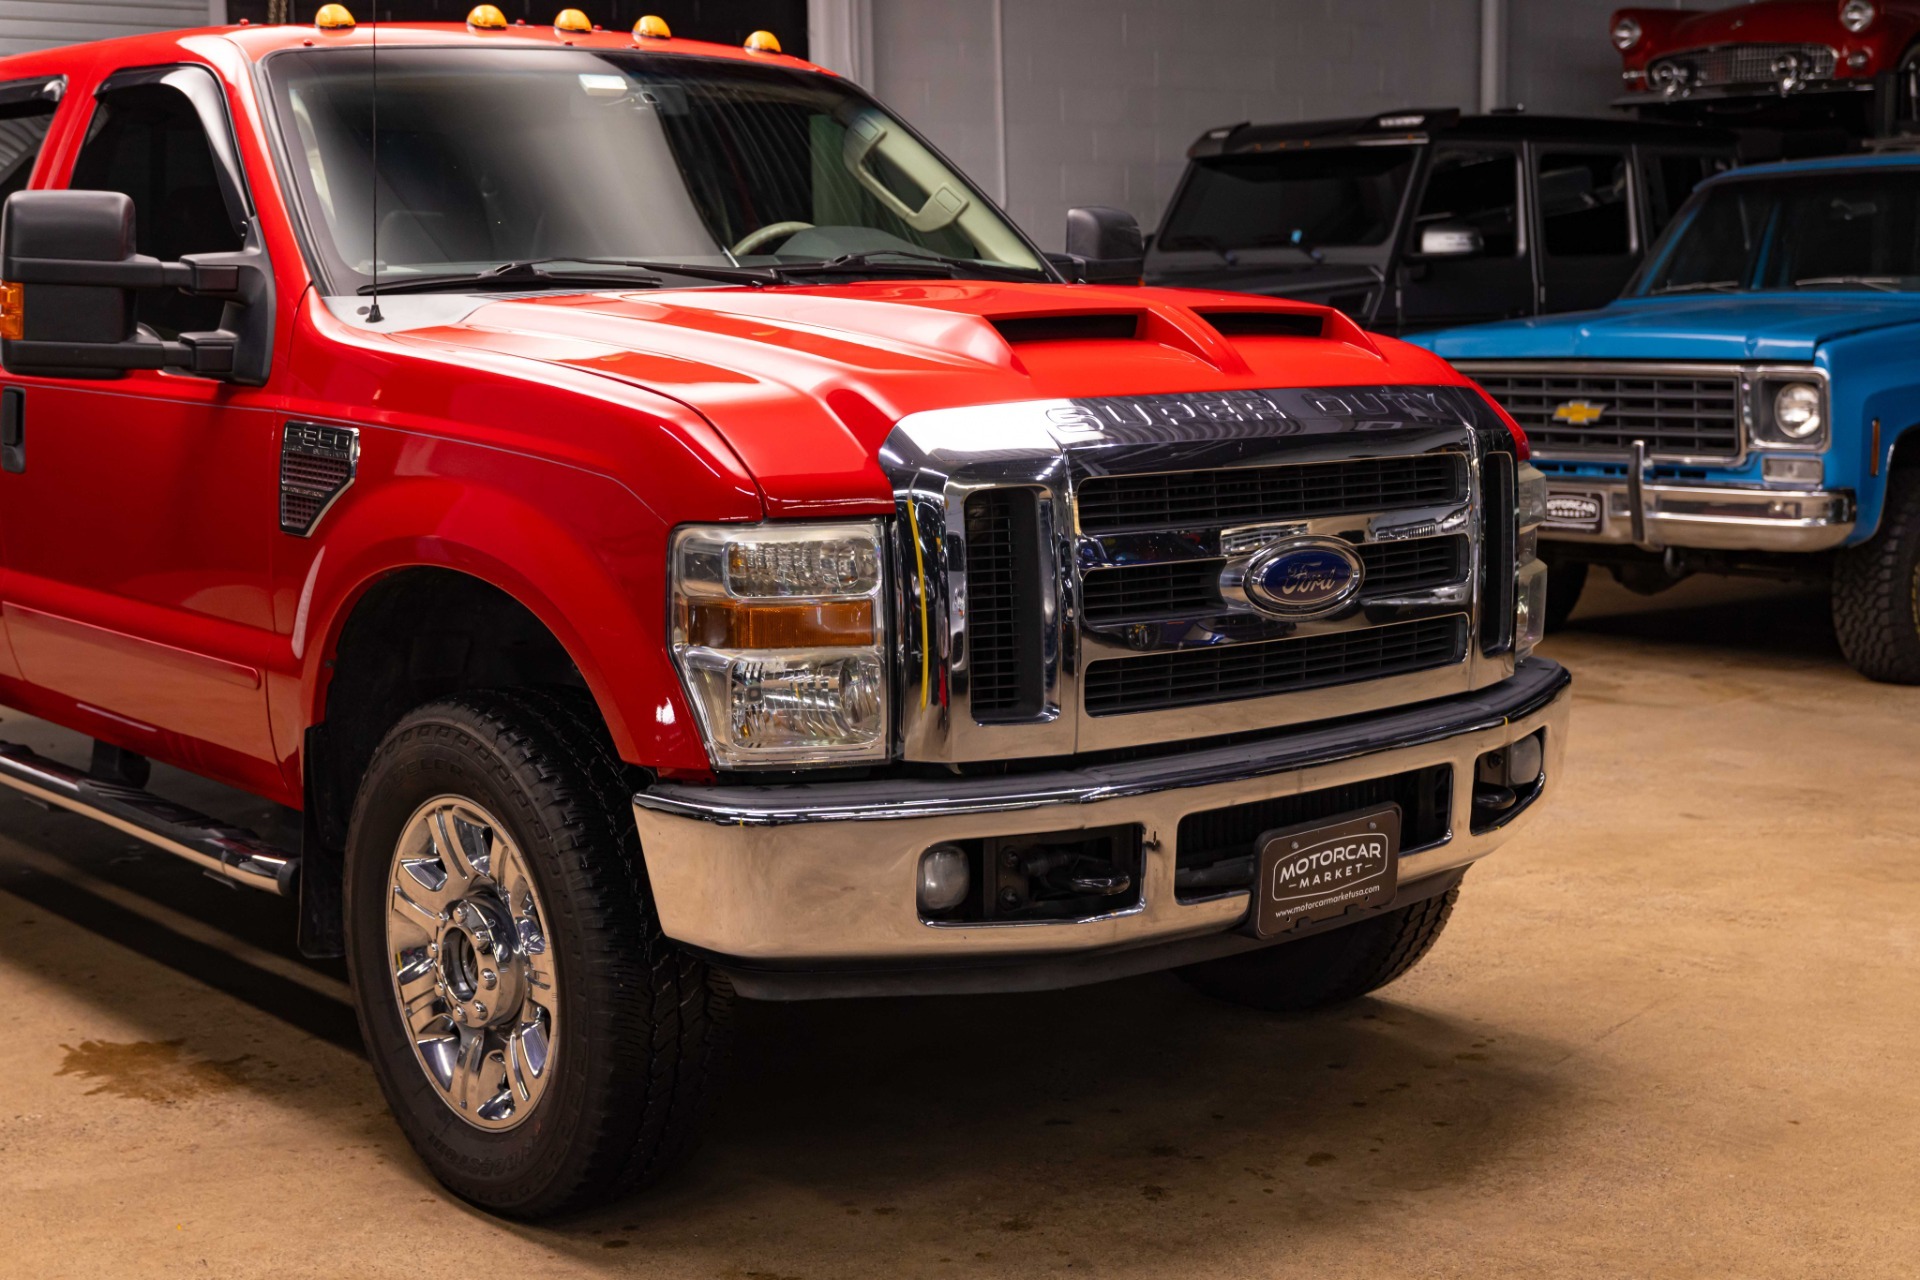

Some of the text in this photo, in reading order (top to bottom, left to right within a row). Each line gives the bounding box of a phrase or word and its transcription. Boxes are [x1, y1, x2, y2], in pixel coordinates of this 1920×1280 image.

[1046, 392, 1445, 433] SUPER DUTY
[1282, 560, 1337, 595] Ford
[1279, 842, 1382, 884] MOTORCAR
[1298, 863, 1363, 889] MARKET
[1275, 884, 1380, 918] www.motorcarmarketusa.com
